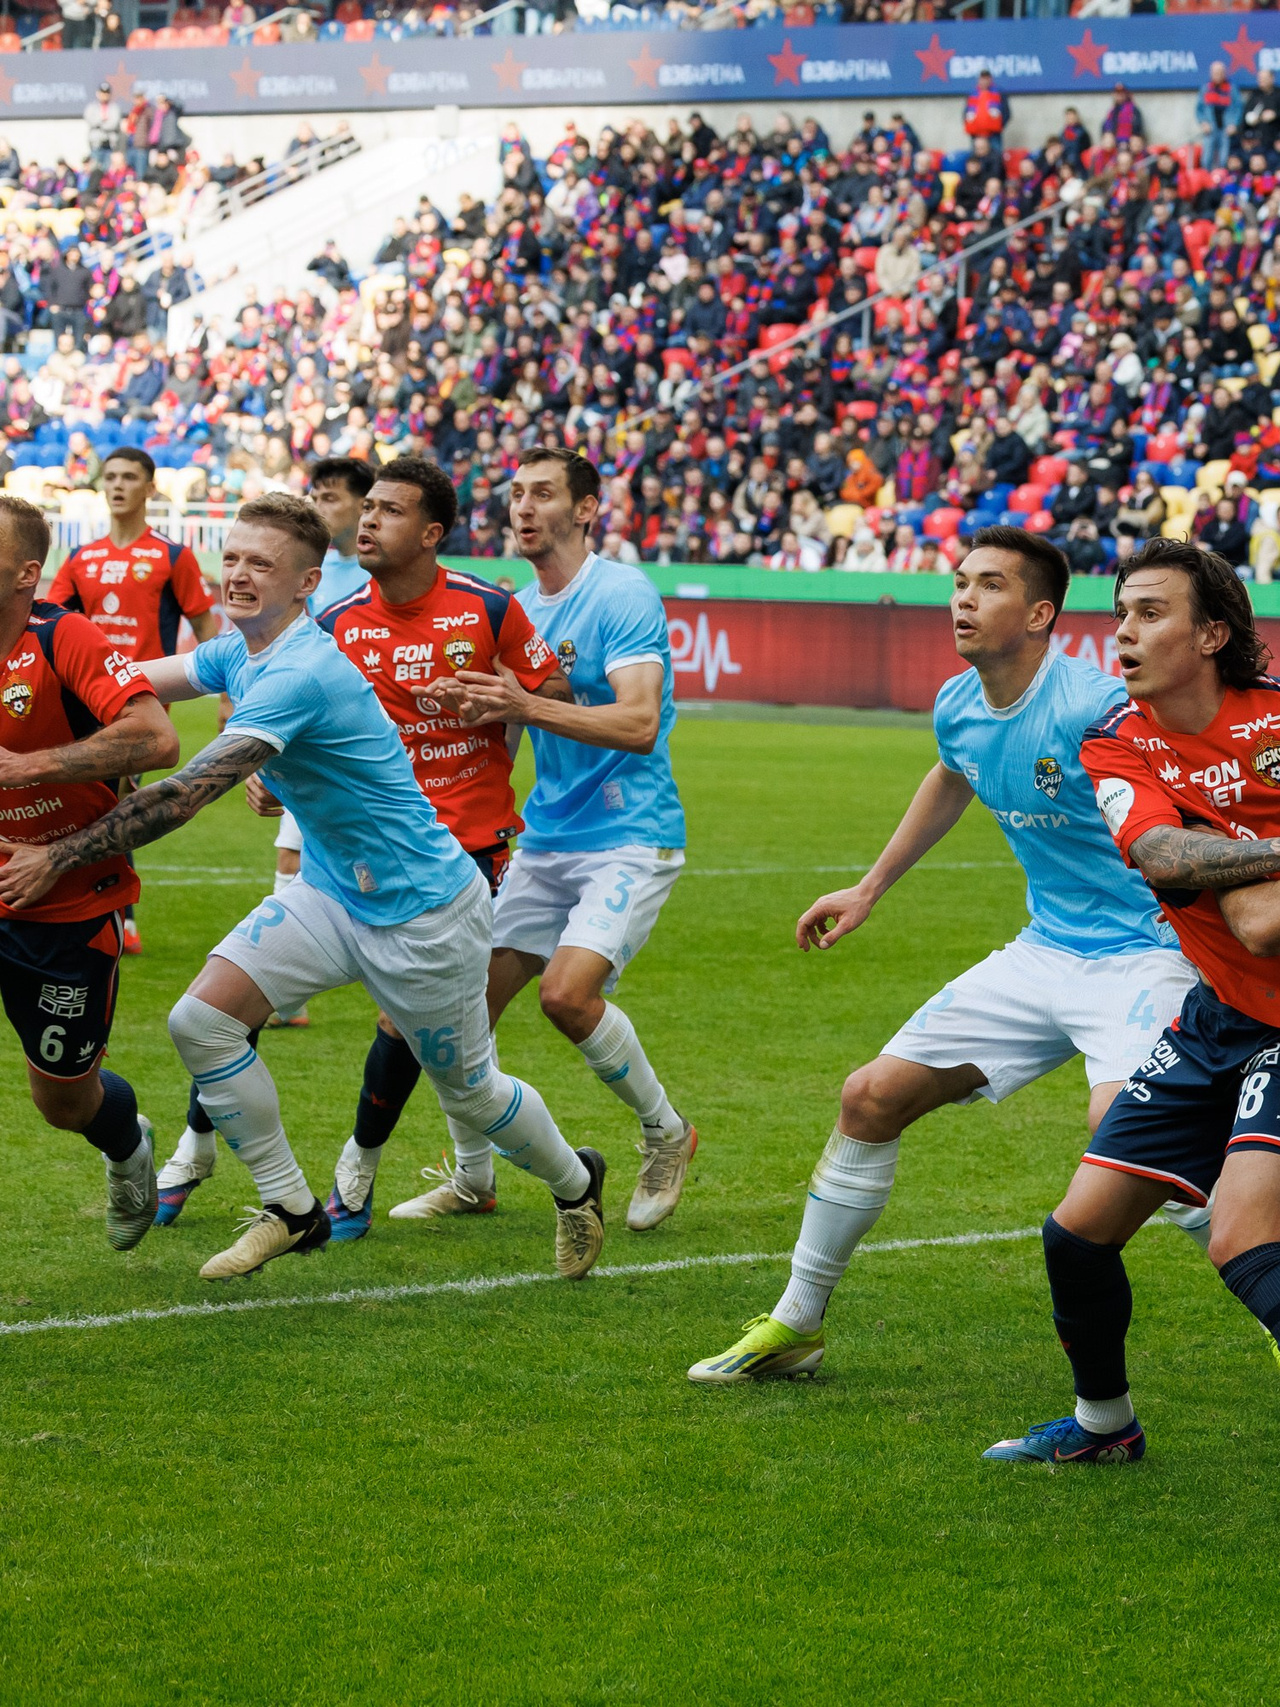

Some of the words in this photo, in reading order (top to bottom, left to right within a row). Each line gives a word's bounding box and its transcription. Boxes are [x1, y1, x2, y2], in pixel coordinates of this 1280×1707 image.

[361, 627, 391, 640] ПСБ
[393, 643, 433, 663] FON
[445, 641, 474, 655] ЦСКА
[530, 643, 550, 669] BET
[103, 651, 129, 675] FO
[114, 663, 142, 687] BE
[395, 662, 435, 681] BET
[420, 736, 489, 761] билайн
[1189, 758, 1240, 788] FON
[605, 870, 635, 914] 3
[1126, 990, 1158, 1030] 4
[39, 1024, 67, 1063] 6
[414, 1026, 456, 1069] 16
[1140, 1057, 1166, 1078] ET
